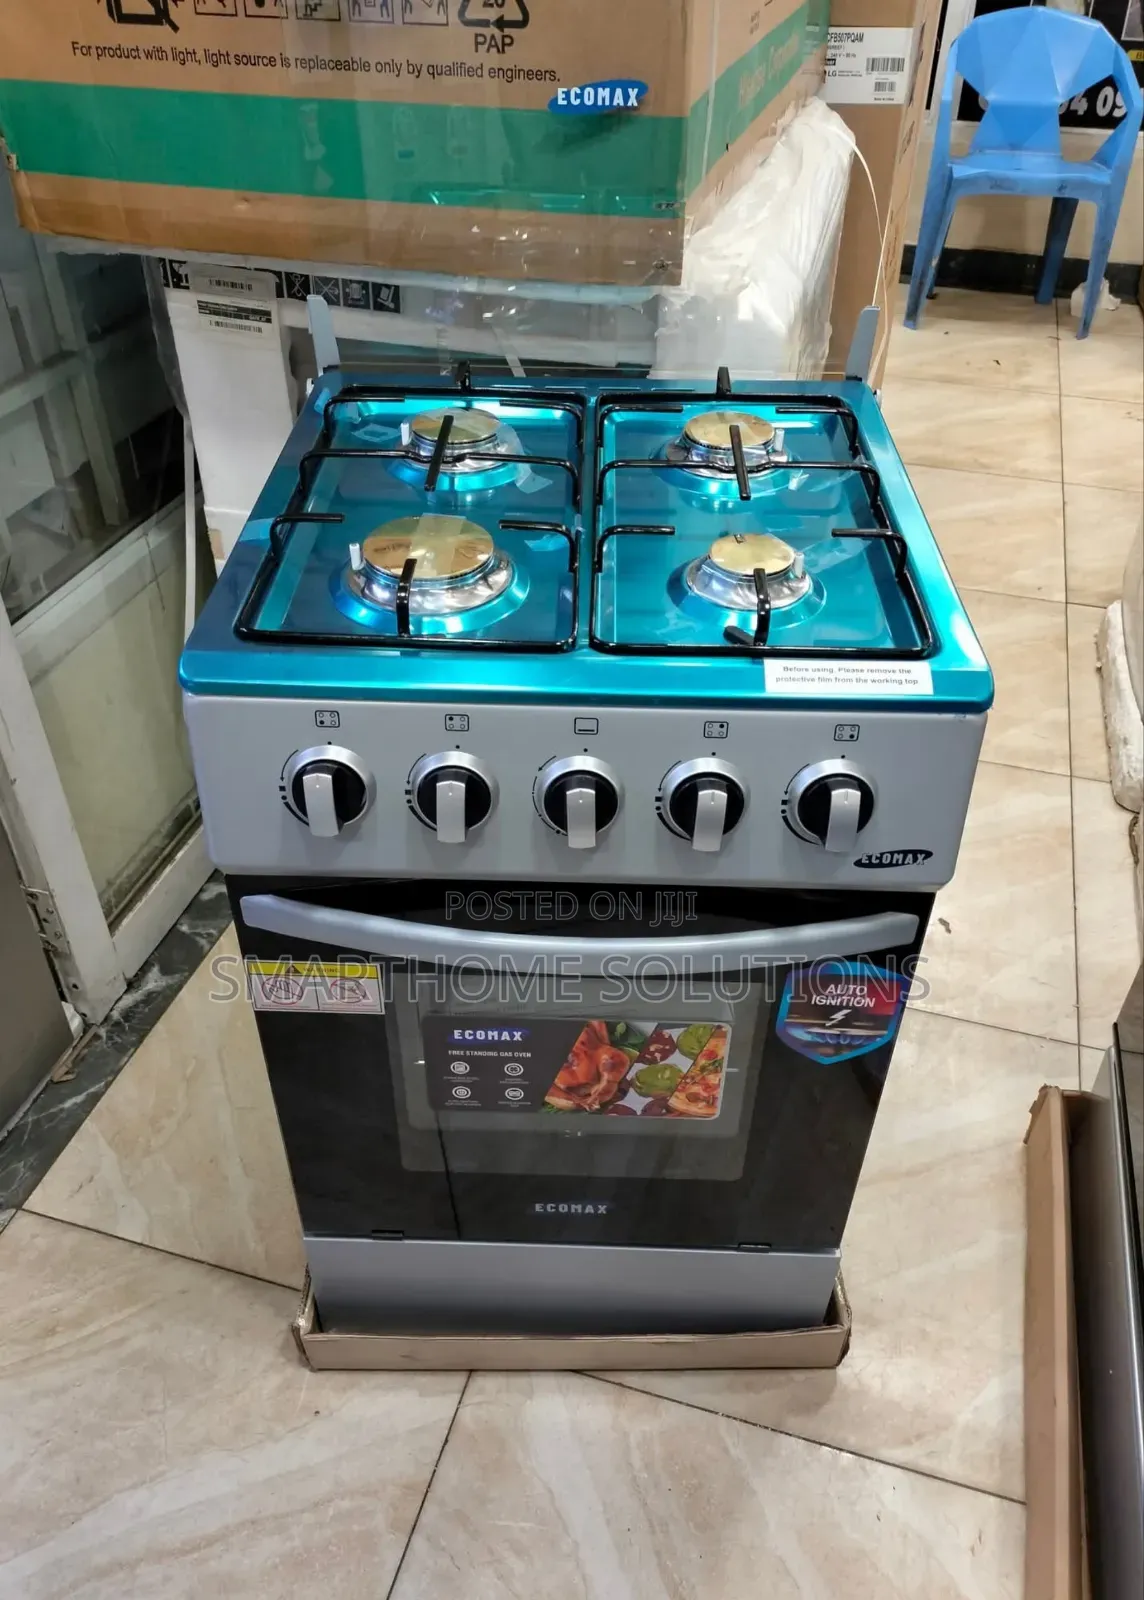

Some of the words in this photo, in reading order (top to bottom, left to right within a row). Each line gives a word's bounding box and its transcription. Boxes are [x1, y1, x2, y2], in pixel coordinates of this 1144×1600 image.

[474, 33, 514, 54] PAP
[71, 41, 93, 57] For
[95, 44, 141, 61] product
[143, 46, 169, 61] with
[171, 46, 202, 66] light,
[203, 48, 232, 68] light
[233, 54, 277, 68] source
[279, 52, 292, 68] is
[294, 55, 371, 73] replaceable
[375, 58, 403, 77] only
[406, 59, 423, 79] by
[426, 61, 484, 79] qualified
[488, 64, 561, 83] engineers.
[557, 87, 639, 106] ECOMAX
[838, 666, 865, 674] Please
[870, 677, 903, 686] working
[861, 852, 926, 866] ECOMAX
[826, 984, 867, 996] AUTO
[811, 995, 875, 1008] IGNITION
[453, 1029, 522, 1041] ECOMAX
[534, 1203, 607, 1214] ECOMAX
